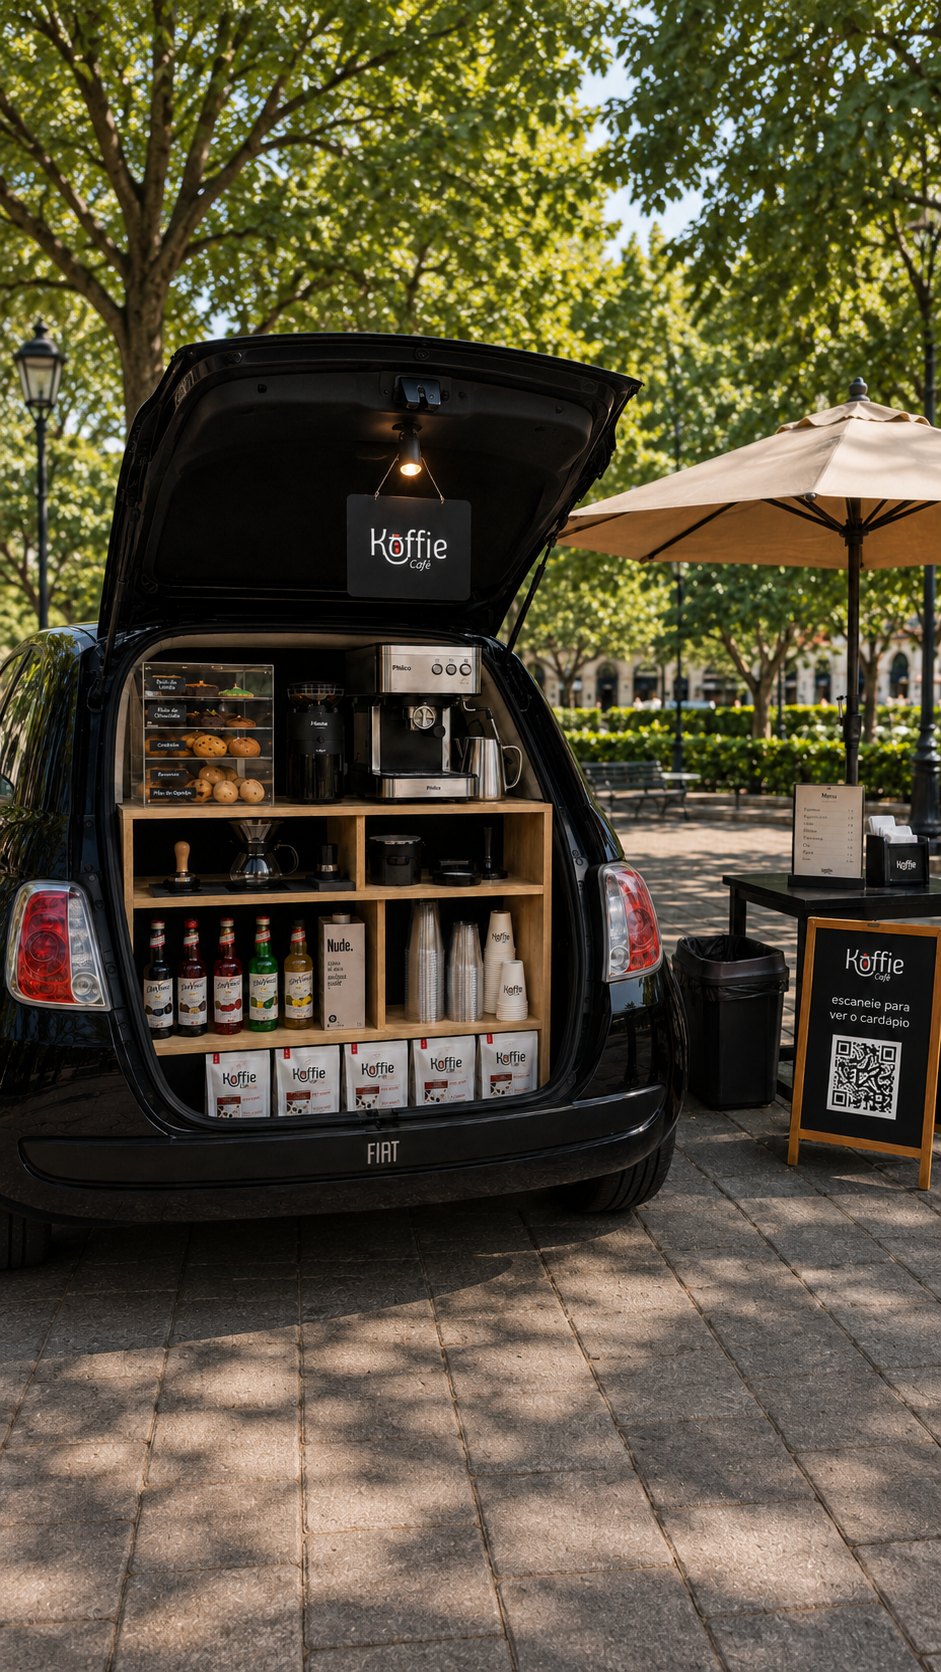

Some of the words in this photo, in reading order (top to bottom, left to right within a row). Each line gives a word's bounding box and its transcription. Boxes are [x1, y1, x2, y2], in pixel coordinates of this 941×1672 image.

[371, 528, 447, 565] Koffie
[409, 559, 432, 572] Café
[327, 938, 354, 953] Nude.
[845, 948, 905, 977] Koffie
[831, 996, 881, 1009] escaneie
[884, 1002, 910, 1012] para
[829, 1011, 848, 1021] ver
[850, 1013, 857, 1022] o
[860, 1015, 910, 1029] cardápio
[430, 1056, 462, 1072] Koffie
[496, 1050, 526, 1066] Koffie
[292, 1066, 326, 1083] Koffie
[361, 1061, 395, 1078] Koffie
[222, 1070, 257, 1088] Koffie
[367, 1140, 400, 1165] FIAT
